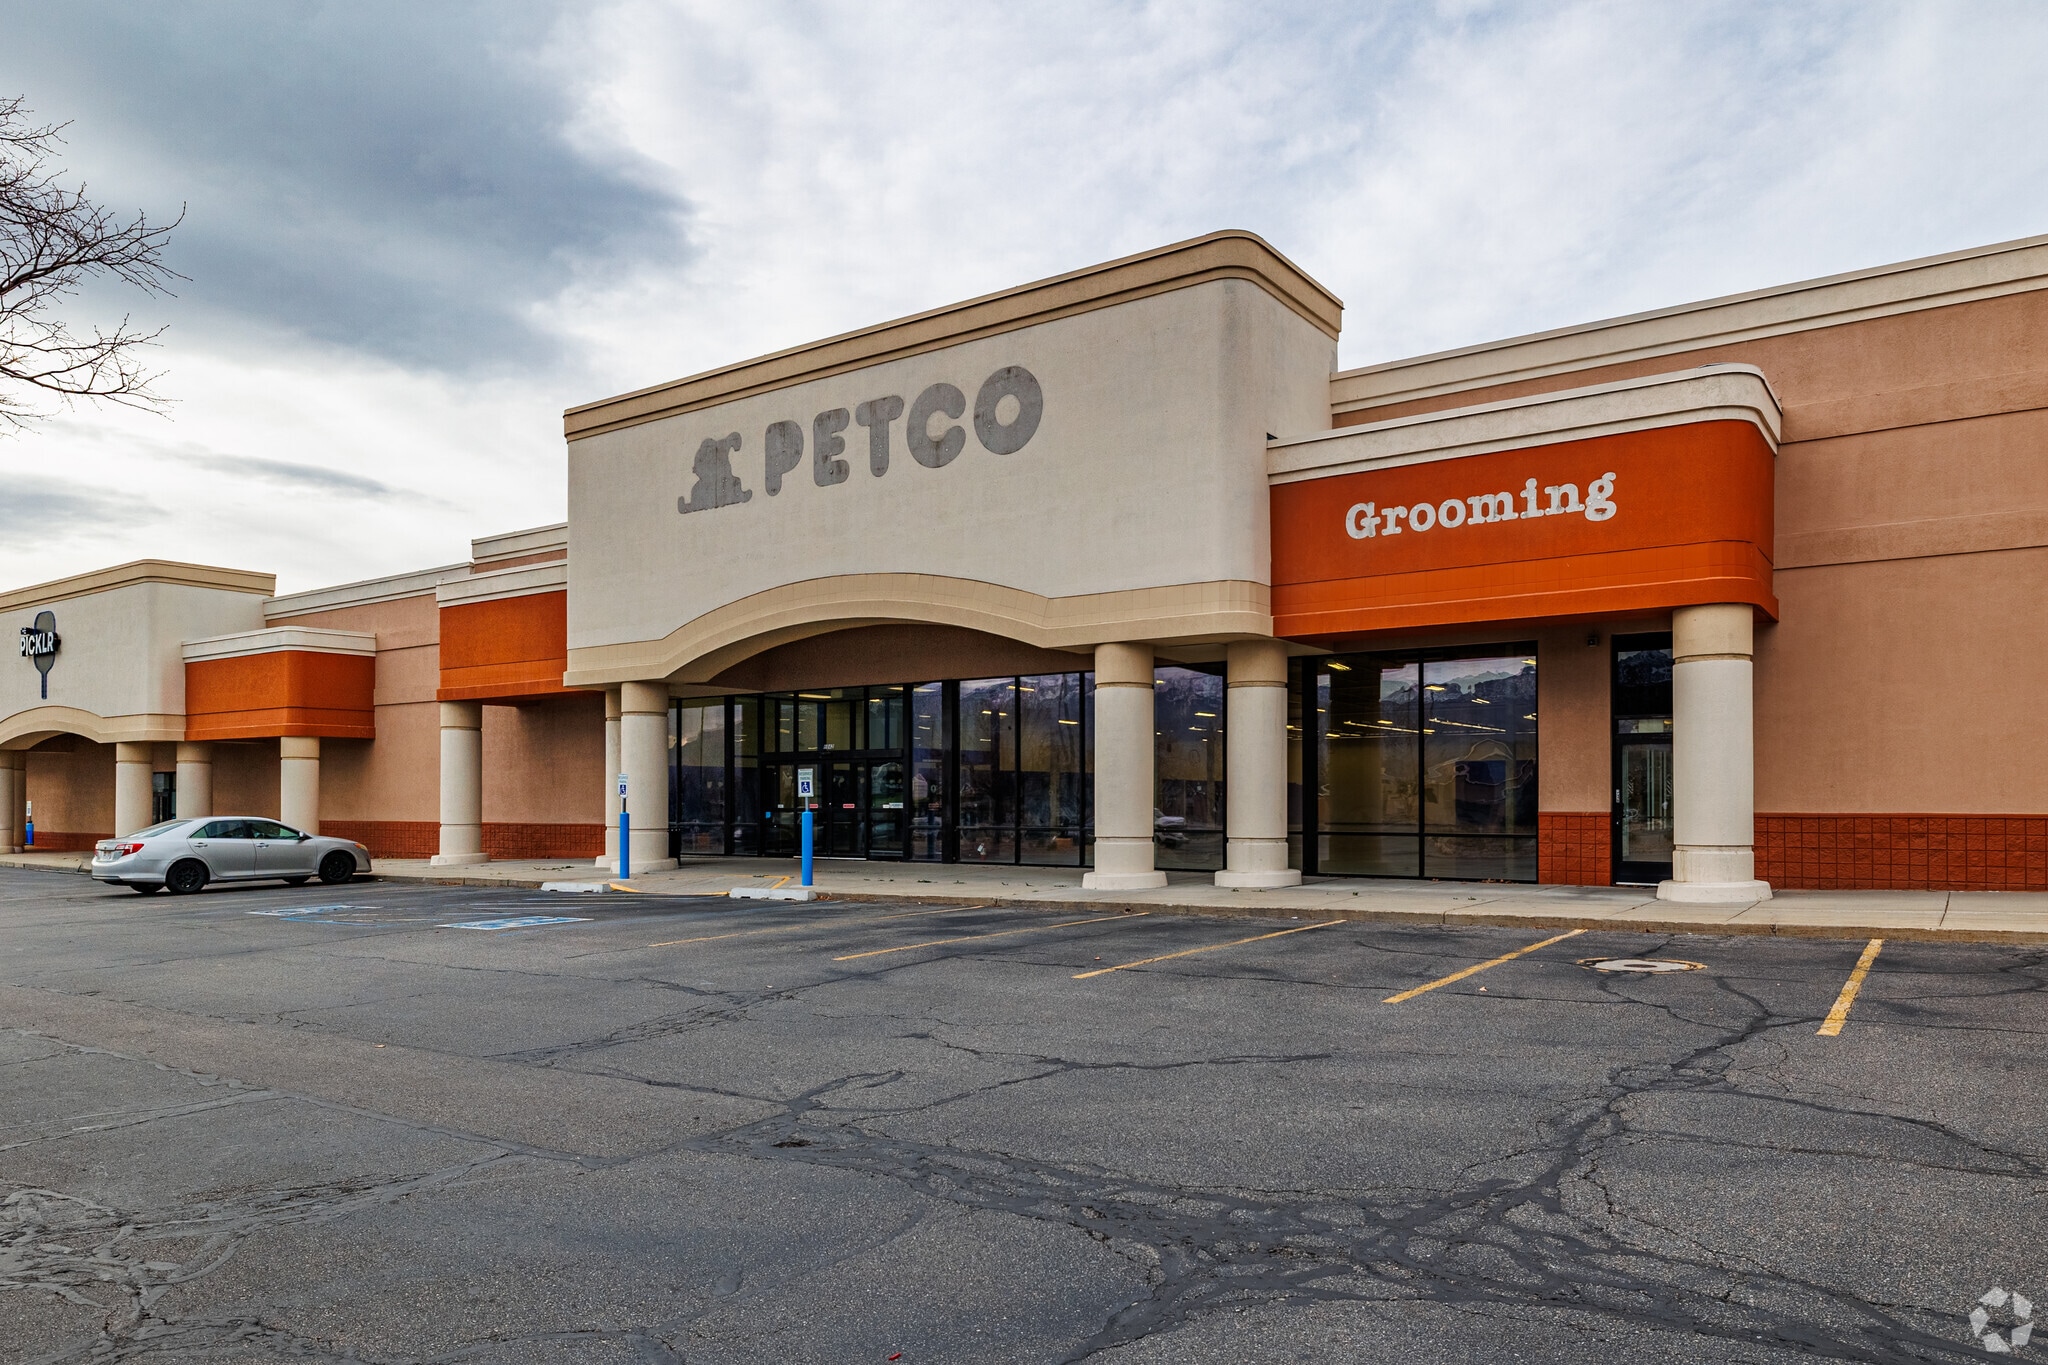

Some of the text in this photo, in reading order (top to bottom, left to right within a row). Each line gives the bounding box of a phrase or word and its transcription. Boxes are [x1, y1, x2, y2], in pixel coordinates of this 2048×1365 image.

[765, 365, 1043, 496] PETCO
[1345, 472, 1617, 539] Grooming
[20, 631, 54, 656] PICKLR
